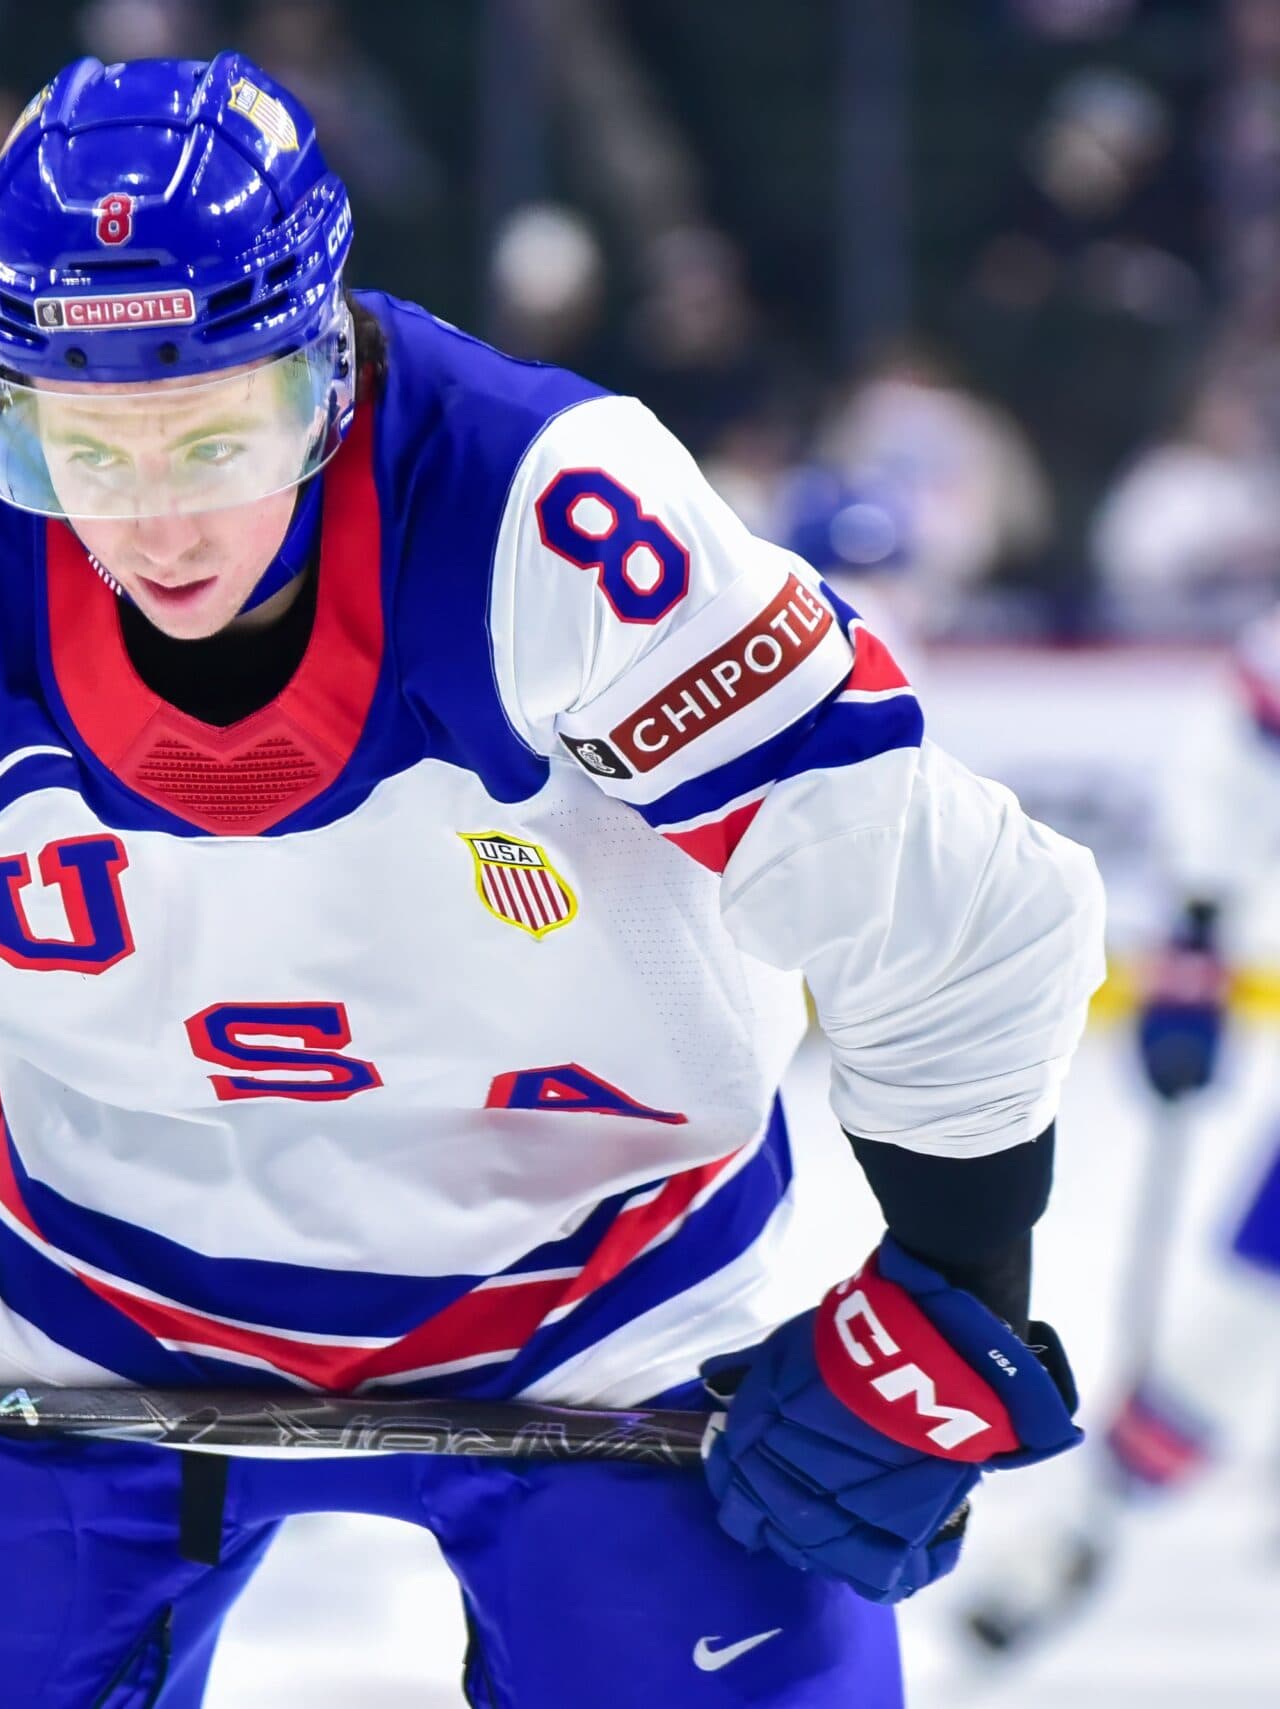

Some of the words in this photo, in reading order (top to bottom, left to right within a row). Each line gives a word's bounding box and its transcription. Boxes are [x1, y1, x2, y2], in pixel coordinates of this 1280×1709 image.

[96, 193, 134, 245] 8
[70, 298, 187, 321] CHIPOTLE
[534, 466, 690, 625] 8
[632, 585, 824, 753] CHIPOTLE
[480, 842, 533, 863] USA
[987, 1348, 1018, 1377] USA
